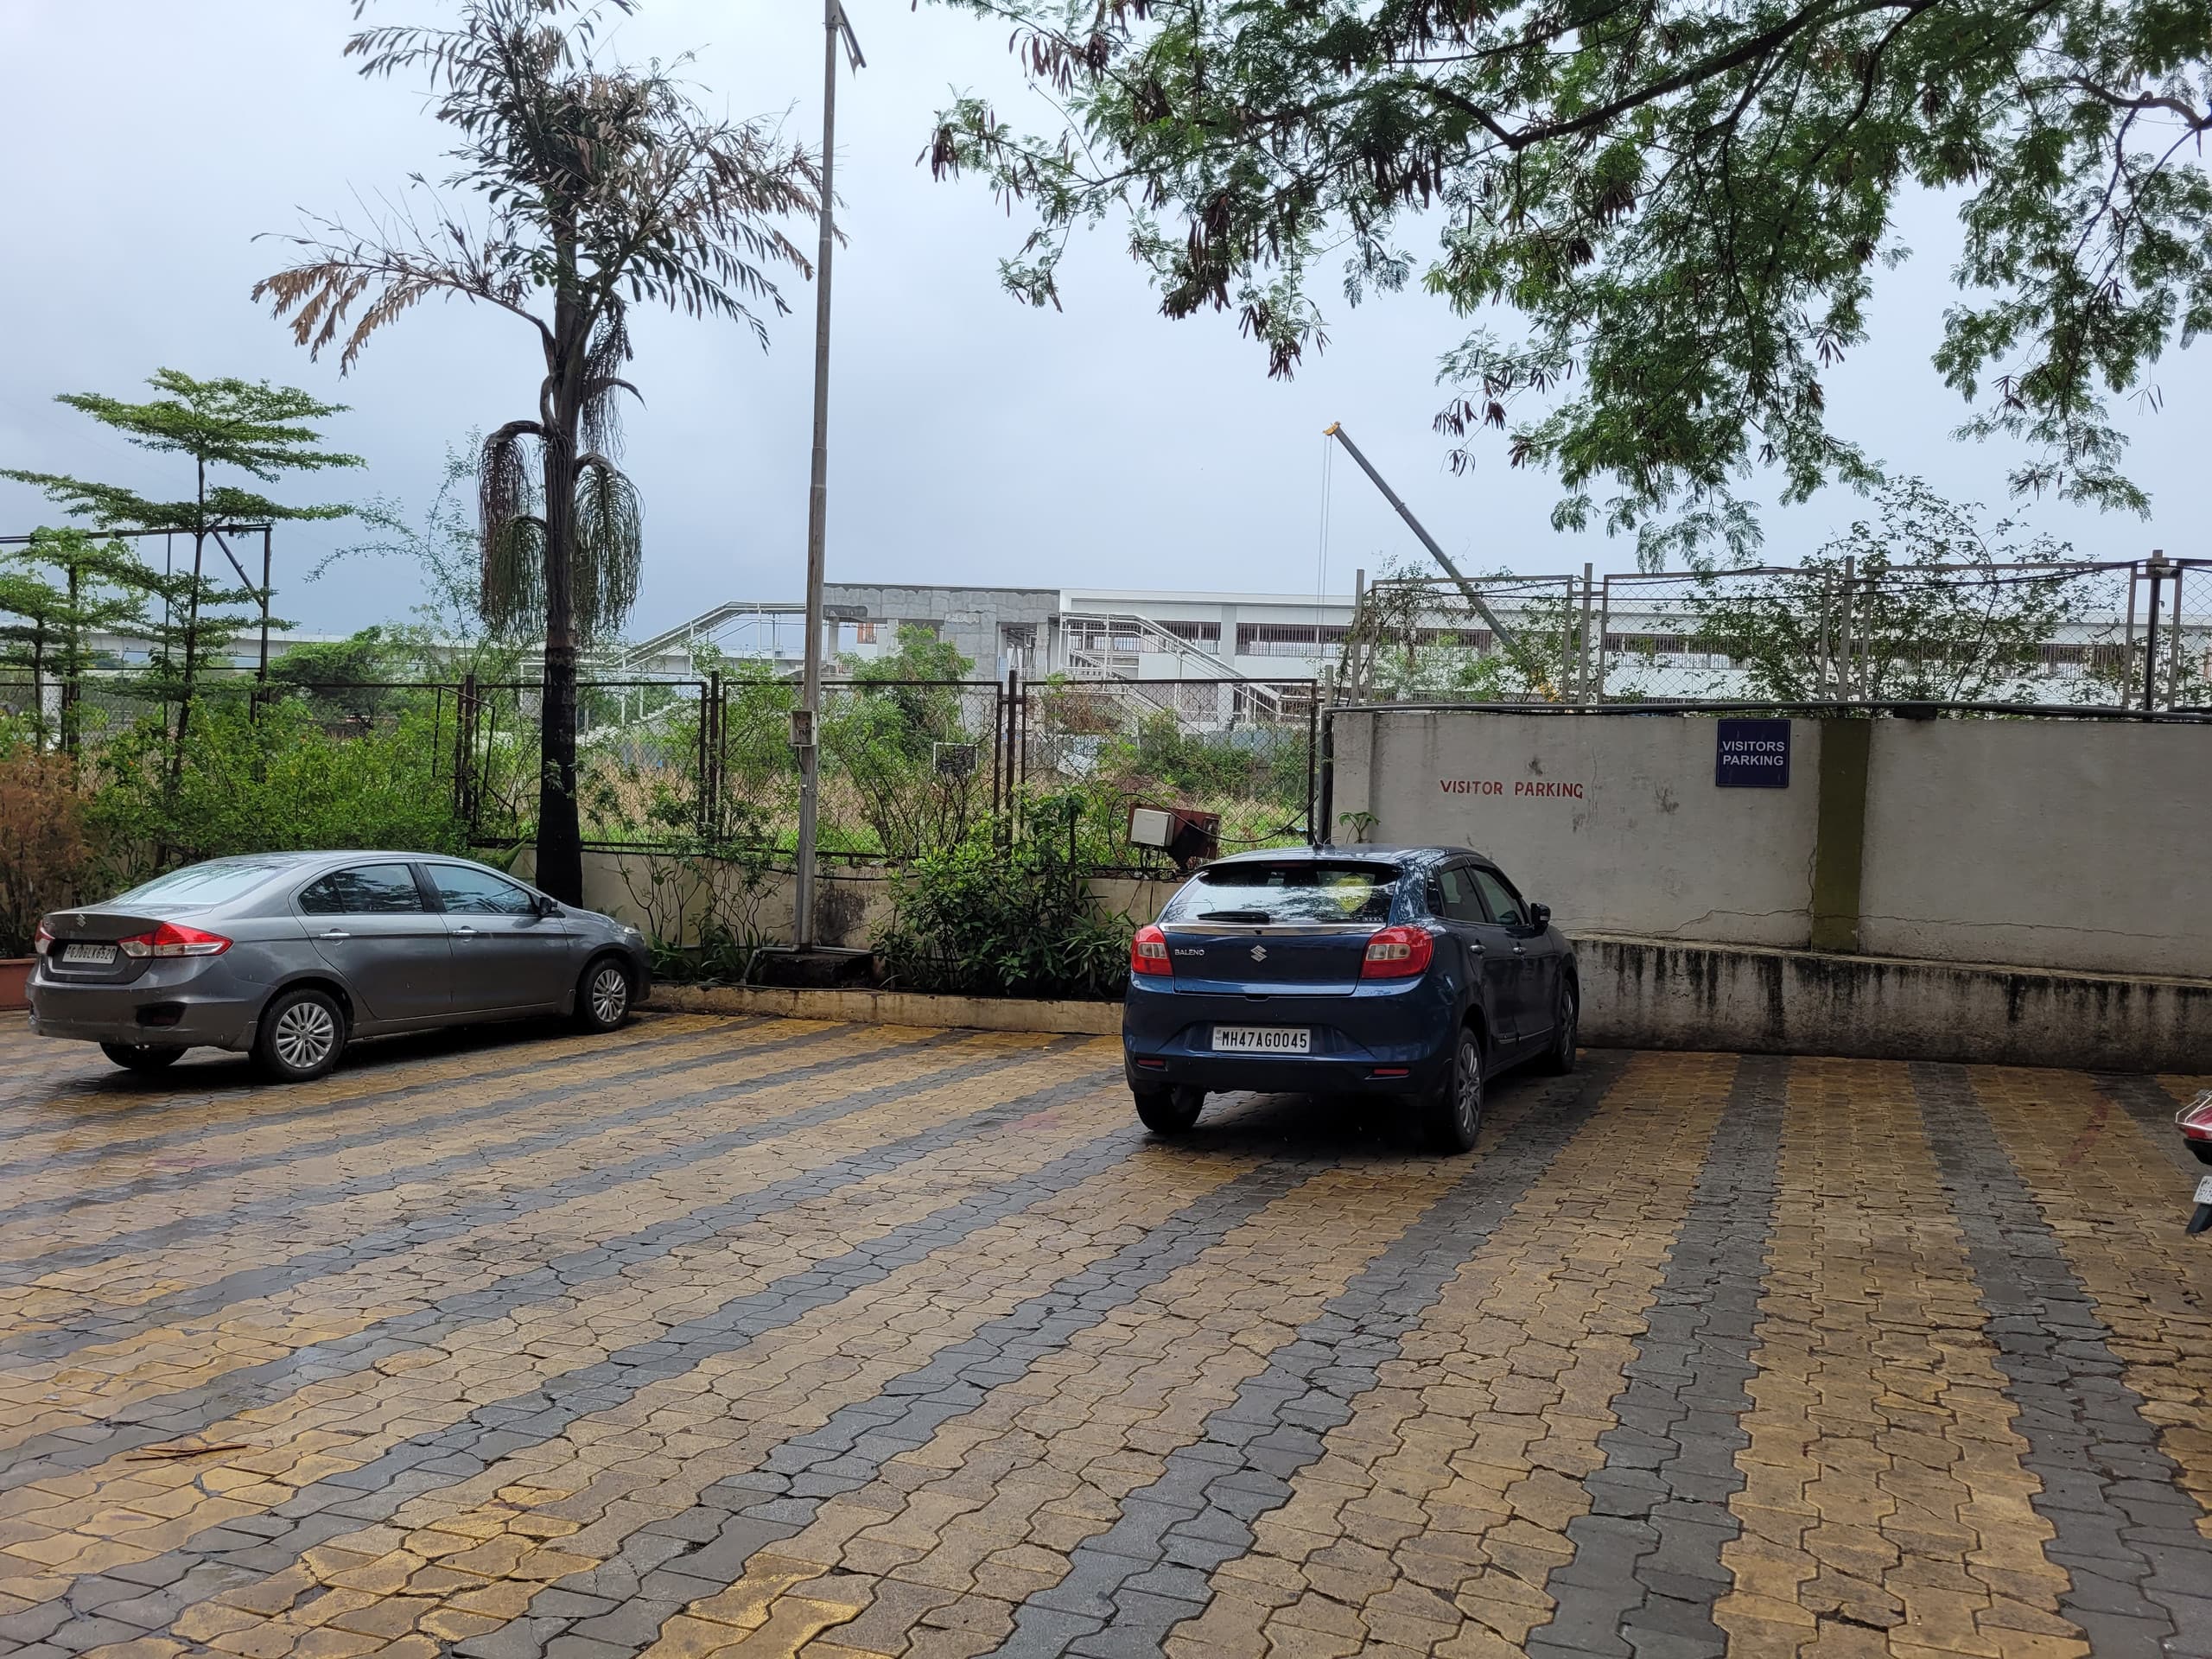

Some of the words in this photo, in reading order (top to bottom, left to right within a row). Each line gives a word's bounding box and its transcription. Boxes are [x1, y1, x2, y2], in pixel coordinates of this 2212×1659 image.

[1722, 741, 1785, 752] VISITORS
[1723, 754, 1784, 766] PARKING
[1440, 779, 1503, 795] VISITOR
[1514, 781, 1584, 799] PARKING
[1222, 1031, 1307, 1048] MH47AG0045
